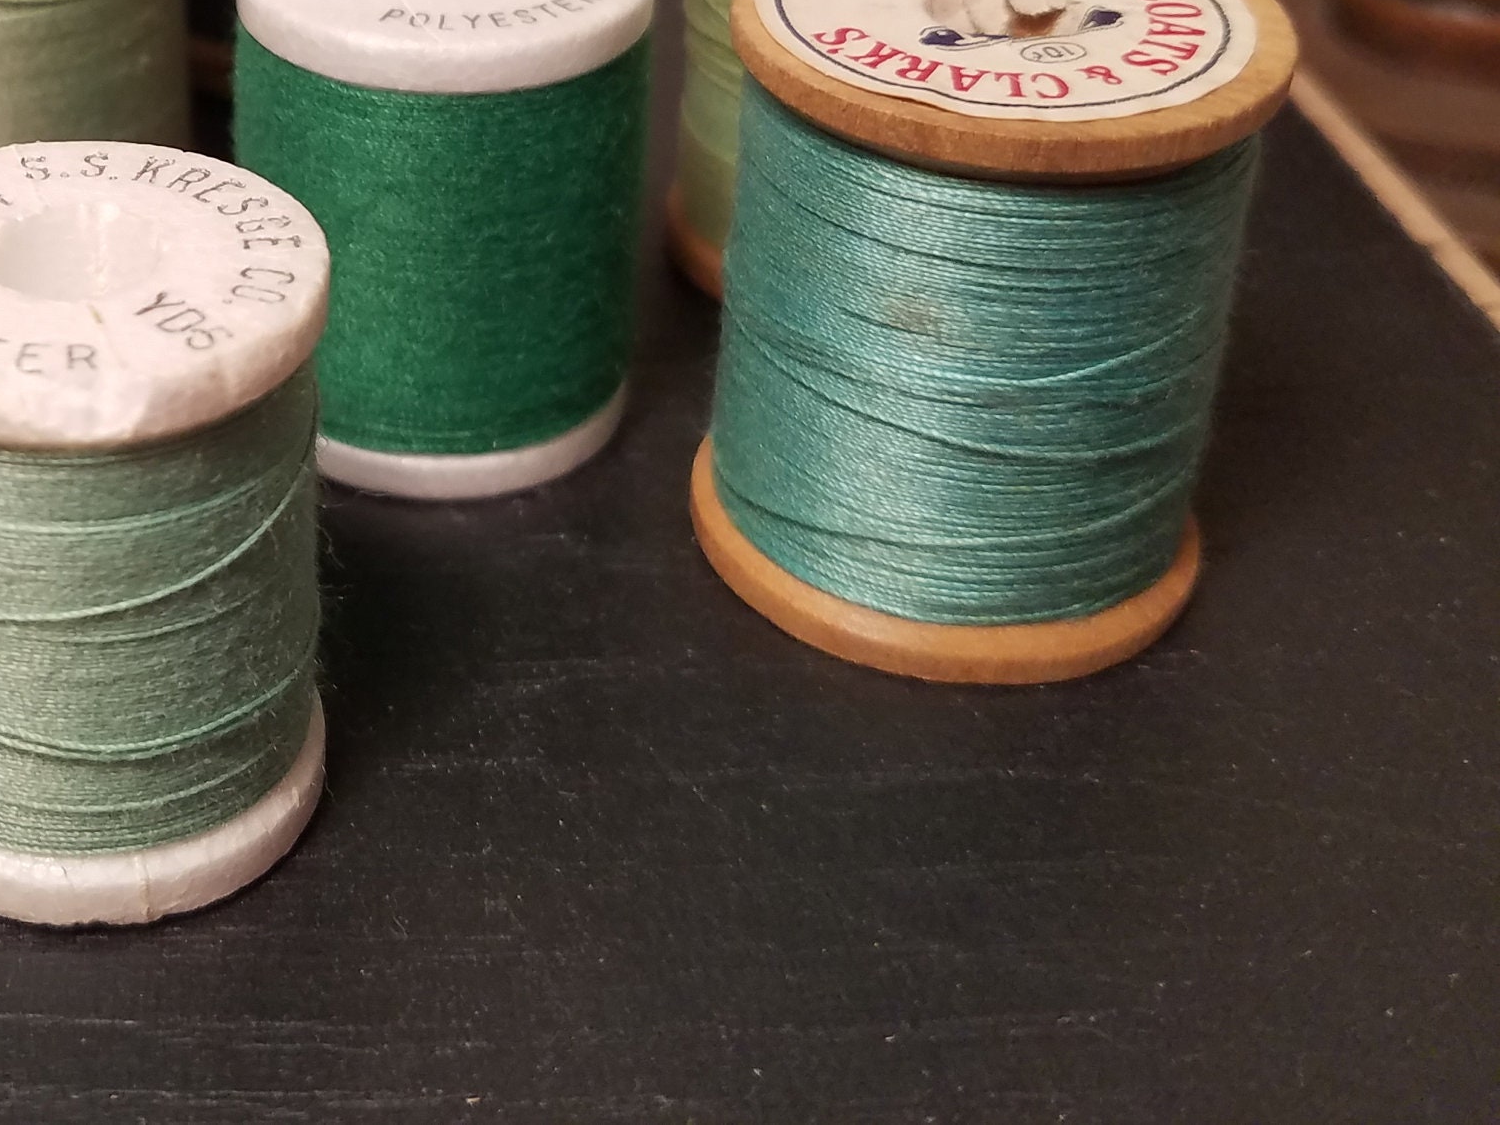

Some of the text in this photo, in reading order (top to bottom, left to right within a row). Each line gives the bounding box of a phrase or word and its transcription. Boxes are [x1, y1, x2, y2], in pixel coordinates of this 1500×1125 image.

[813, 26, 1071, 101] CLARK'S
[1074, 63, 1124, 87] &
[130, 154, 302, 252] KRESGE
[133, 290, 235, 352] YDS
